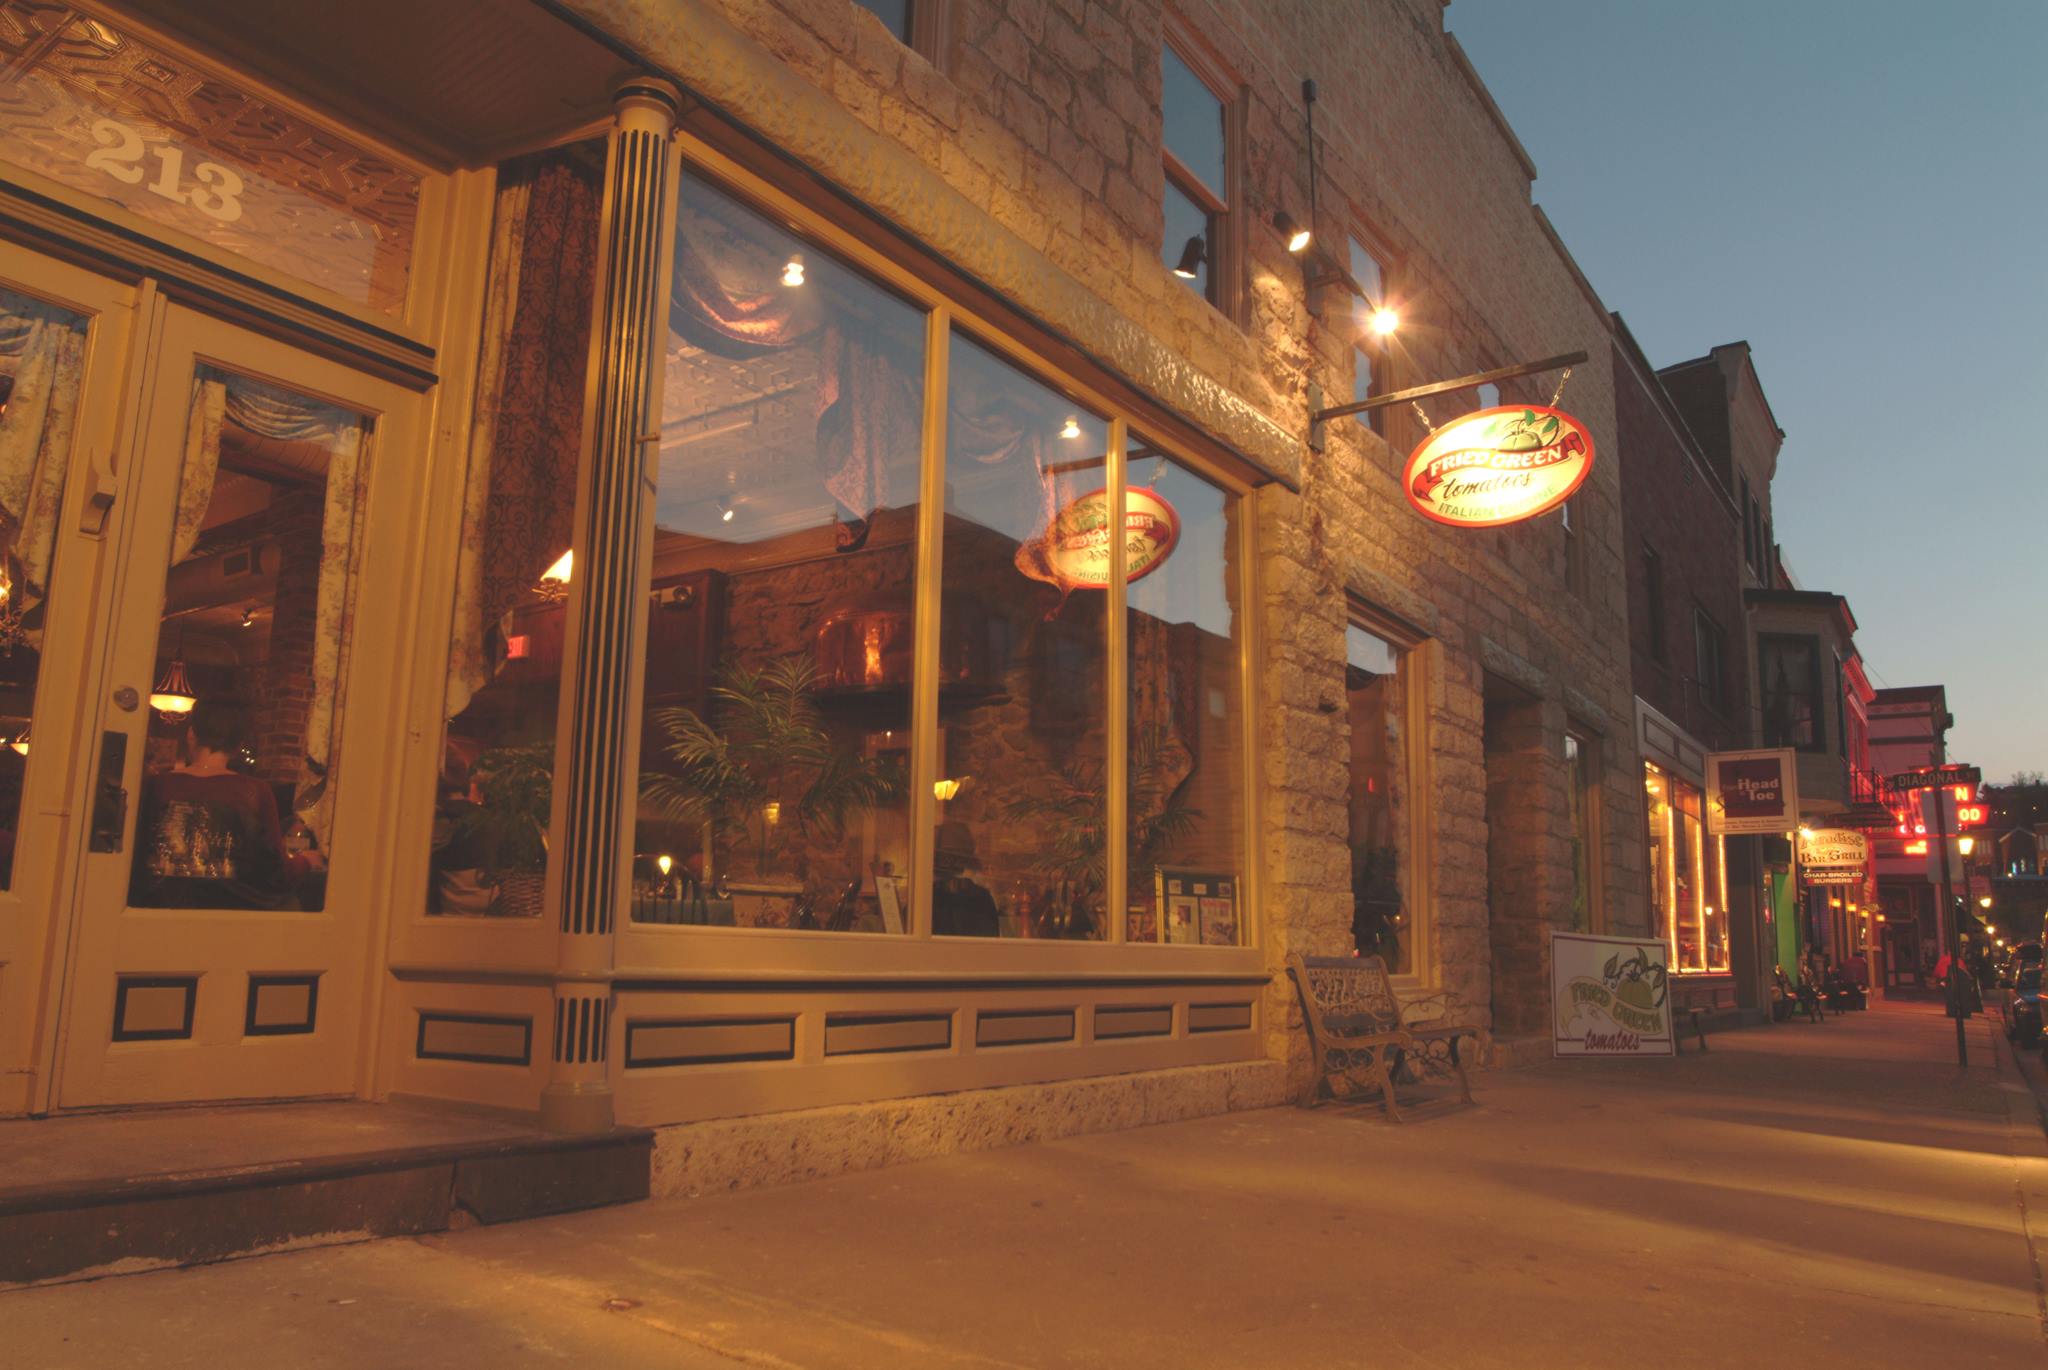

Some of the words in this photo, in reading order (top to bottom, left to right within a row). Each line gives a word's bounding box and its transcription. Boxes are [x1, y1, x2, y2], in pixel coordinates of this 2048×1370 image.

[86, 118, 244, 222] 213
[1430, 451, 1490, 477] FRIED
[1490, 446, 1563, 469] GREEN
[1443, 471, 1531, 500] tomatoes
[1737, 778, 1779, 790] Head
[1898, 769, 1963, 787] DIAGONAL
[1745, 789, 1775, 801] Toe
[1800, 853, 1826, 863] BAR
[1828, 849, 1865, 861] GRILL
[1584, 1028, 1640, 1050] tomatoes
